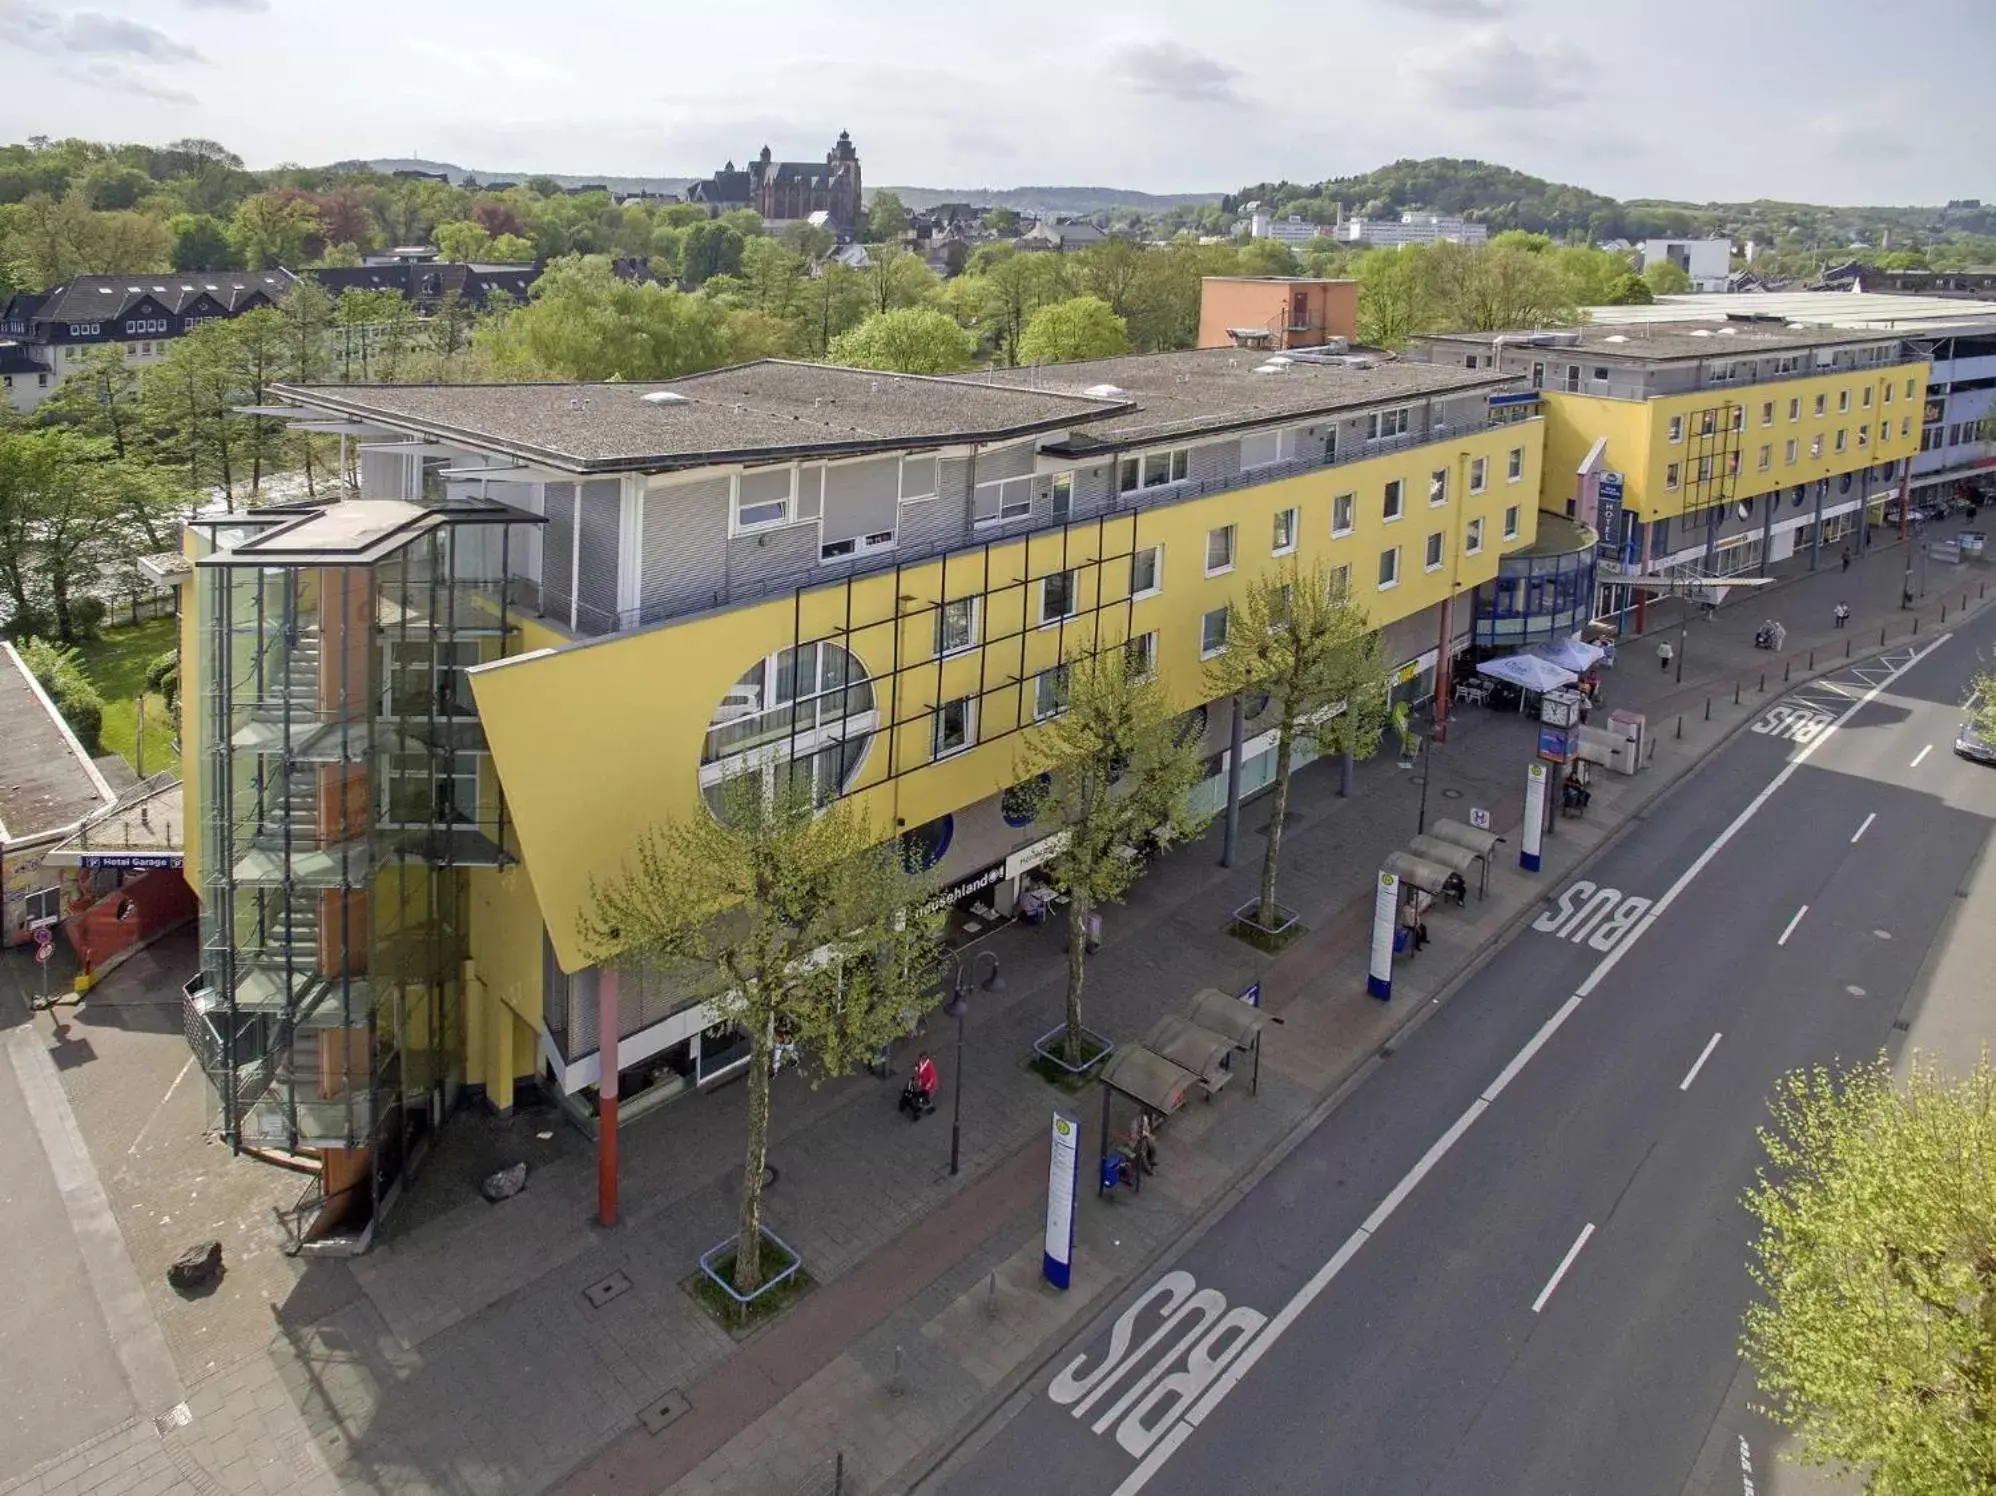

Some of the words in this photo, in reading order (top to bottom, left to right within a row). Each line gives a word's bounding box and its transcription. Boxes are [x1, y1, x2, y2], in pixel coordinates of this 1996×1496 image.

[1604, 503, 1614, 541] HOTEL
[1751, 706, 1834, 744] BUS
[103, 858, 130, 866] Hotel
[132, 858, 167, 868] Garage
[1531, 880, 1653, 952] BUS
[1048, 1270, 1268, 1459] BUS
